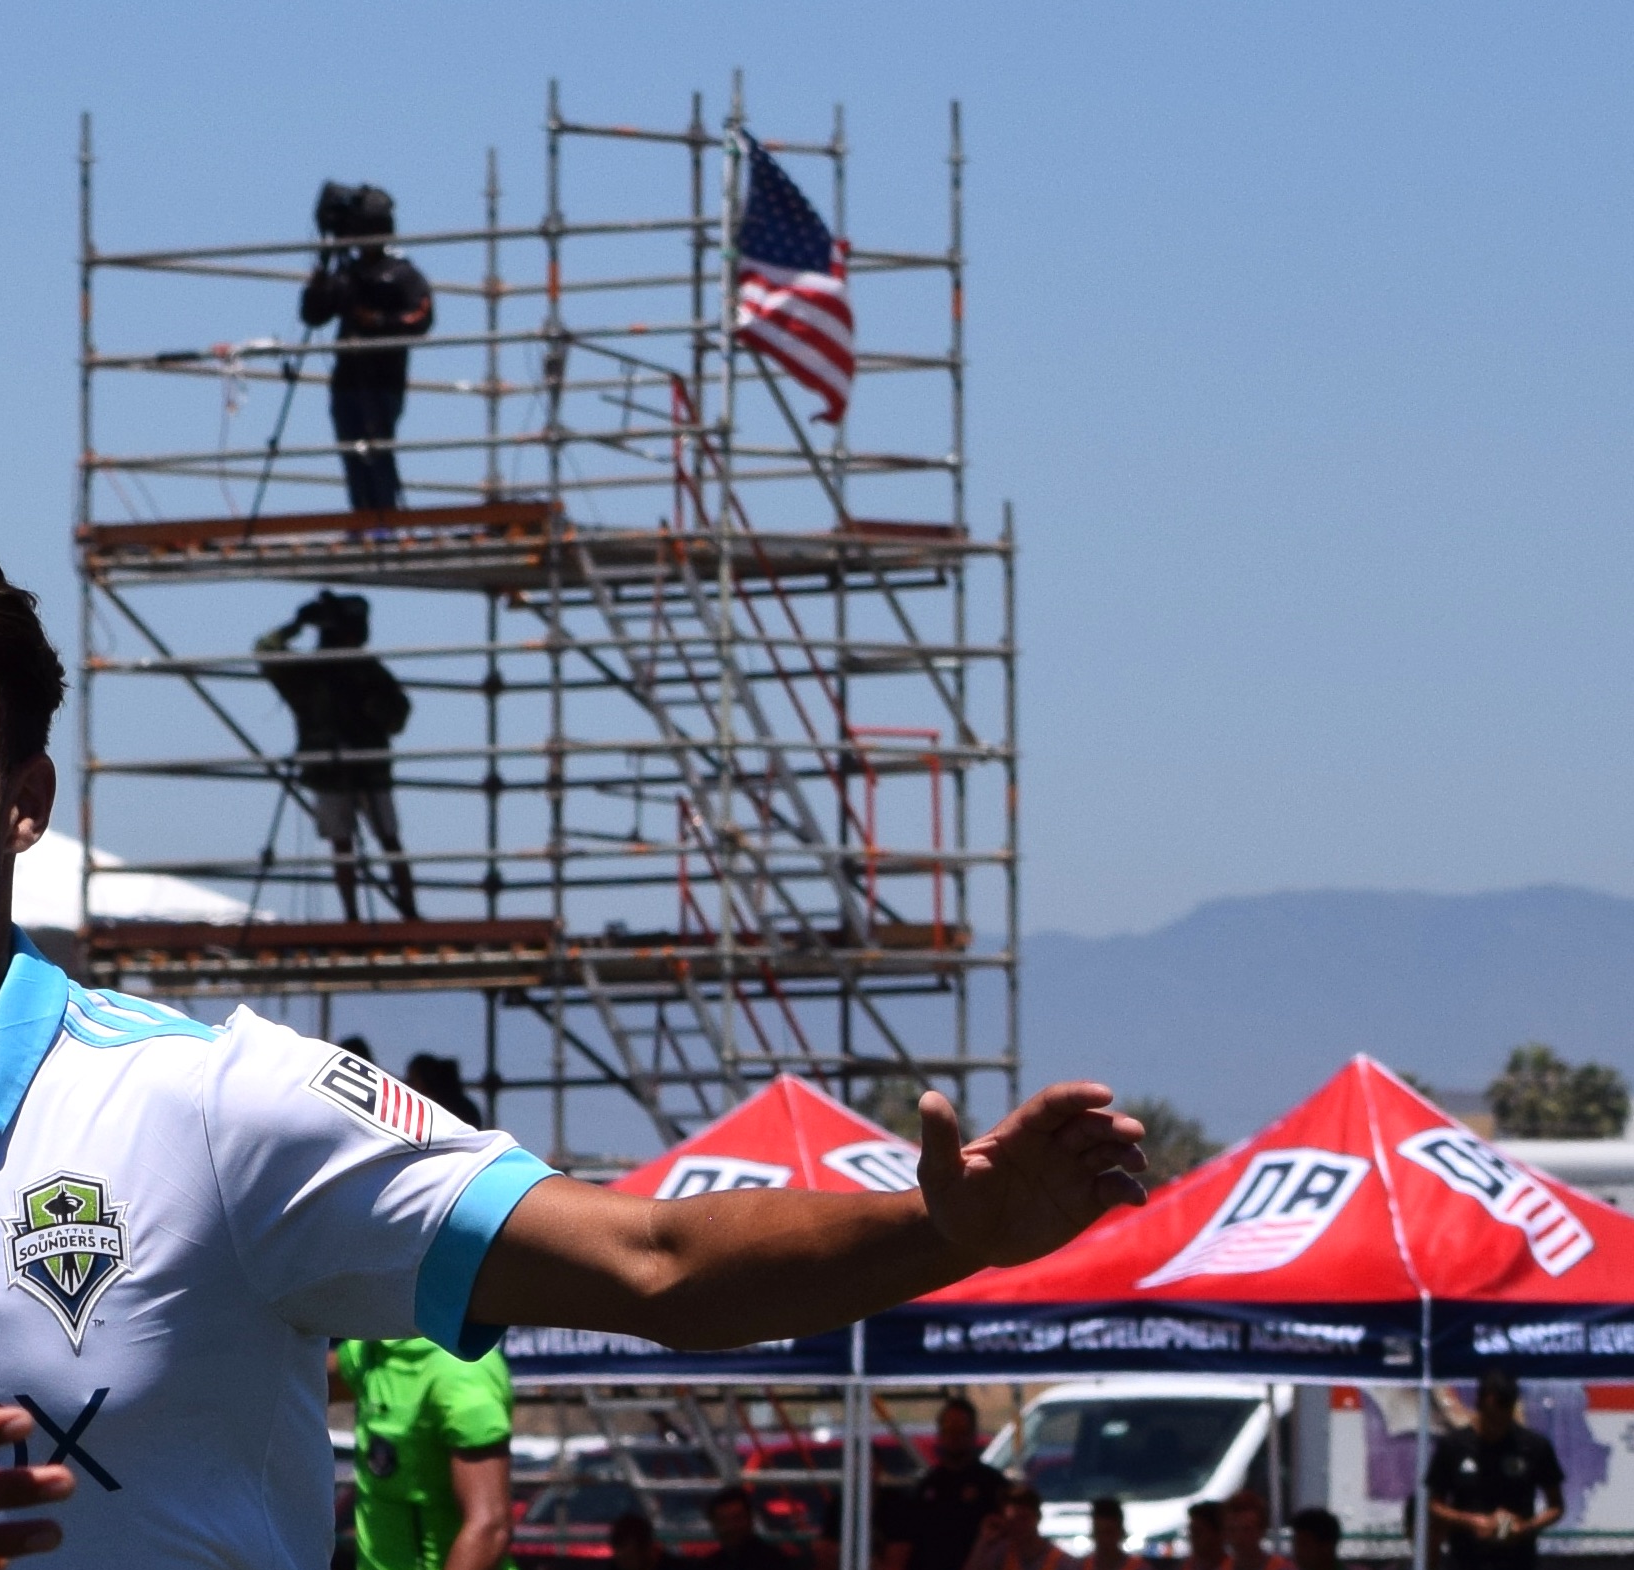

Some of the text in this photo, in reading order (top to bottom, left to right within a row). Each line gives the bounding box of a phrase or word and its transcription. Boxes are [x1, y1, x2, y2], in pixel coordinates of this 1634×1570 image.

[320, 1055, 378, 1116] DA
[1221, 1162, 1349, 1228] DA
[19, 1236, 118, 1262] SOUNDERS FC
[38, 1229, 94, 1240] SEATTLE
[1068, 1317, 1241, 1351] DEVELOPMENT
